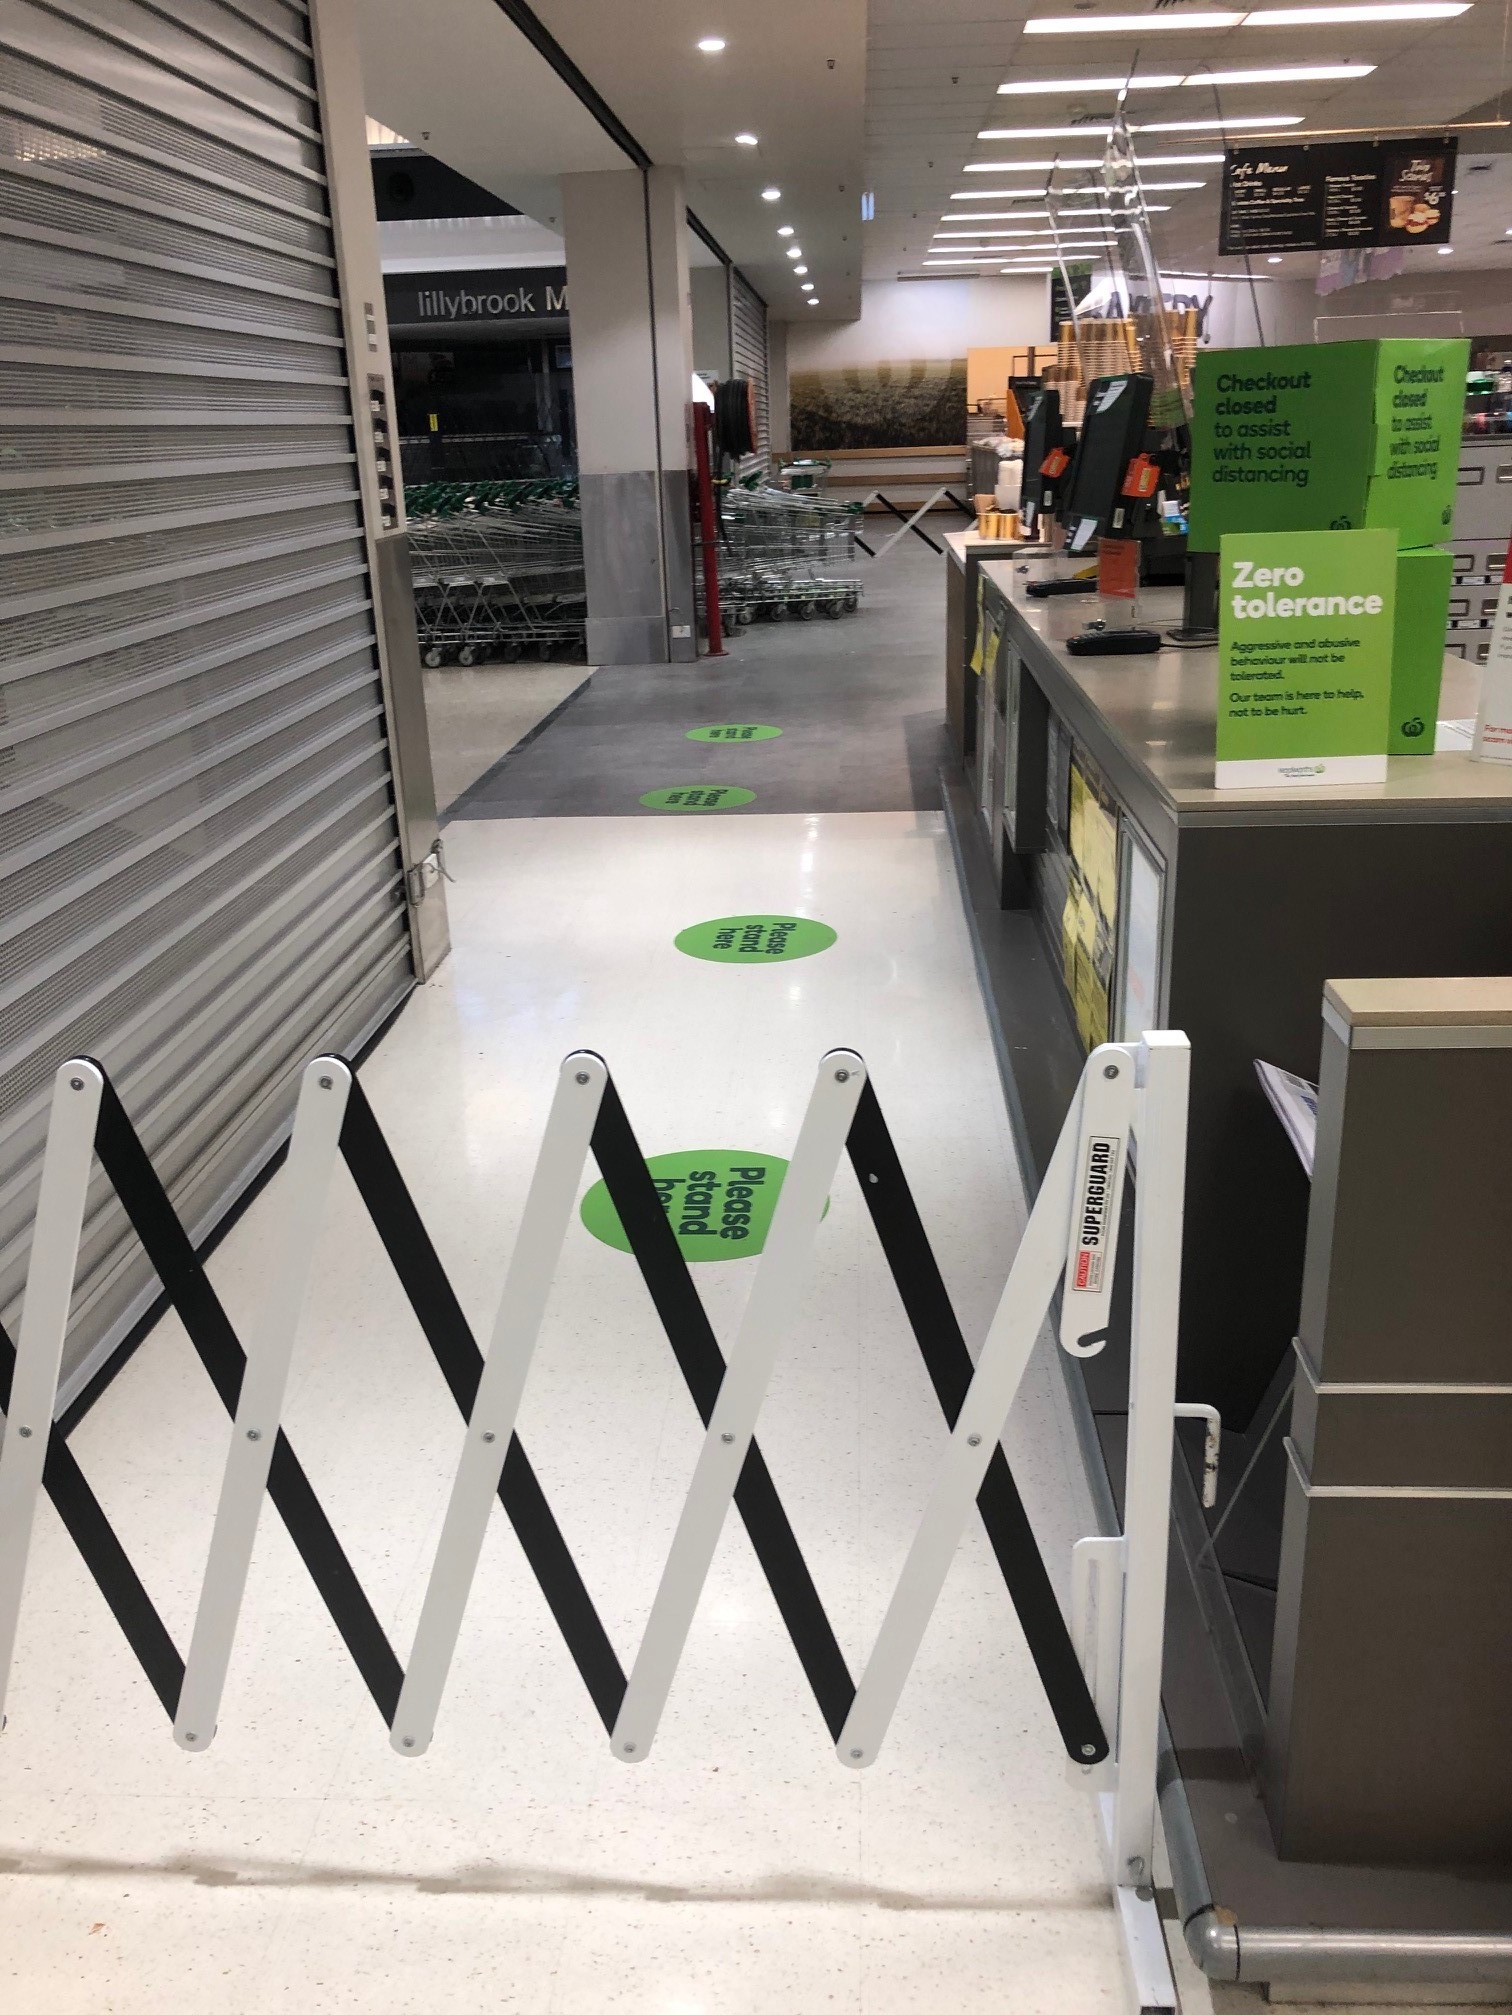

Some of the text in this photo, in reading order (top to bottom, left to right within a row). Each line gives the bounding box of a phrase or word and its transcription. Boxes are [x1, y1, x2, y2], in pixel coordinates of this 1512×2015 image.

[1217, 371, 1312, 393] Checkout
[1394, 364, 1444, 384] Checkout
[1216, 395, 1277, 415] closed
[1392, 388, 1428, 408] closed
[1215, 419, 1291, 438] to assist
[1391, 412, 1432, 432] to assist
[1213, 441, 1312, 460] with social
[1389, 435, 1440, 455] with social
[1213, 465, 1309, 487] distancing
[1387, 460, 1438, 480] distancing
[1232, 562, 1305, 588] Zero
[1232, 592, 1383, 619] tolerance
[1230, 638, 1360, 653] Aggressive and abusive
[1230, 653, 1345, 666] behaviour will not be
[1230, 670, 1285, 680] tolerated.
[1229, 692, 1251, 702] Our
[1253, 693, 1283, 701] team
[1285, 691, 1294, 700] is
[1296, 691, 1321, 699] here
[1323, 690, 1334, 699] to
[1229, 706, 1308, 717] not to be hurt.
[712, 927, 744, 949] here
[738, 924, 767, 953] stand
[765, 922, 797, 954] Please
[678, 1170, 722, 1236] stand
[719, 1167, 766, 1240] Please
[1082, 1142, 1111, 1246] SUPERGUARD
[1076, 1252, 1090, 1287] CAUTION
